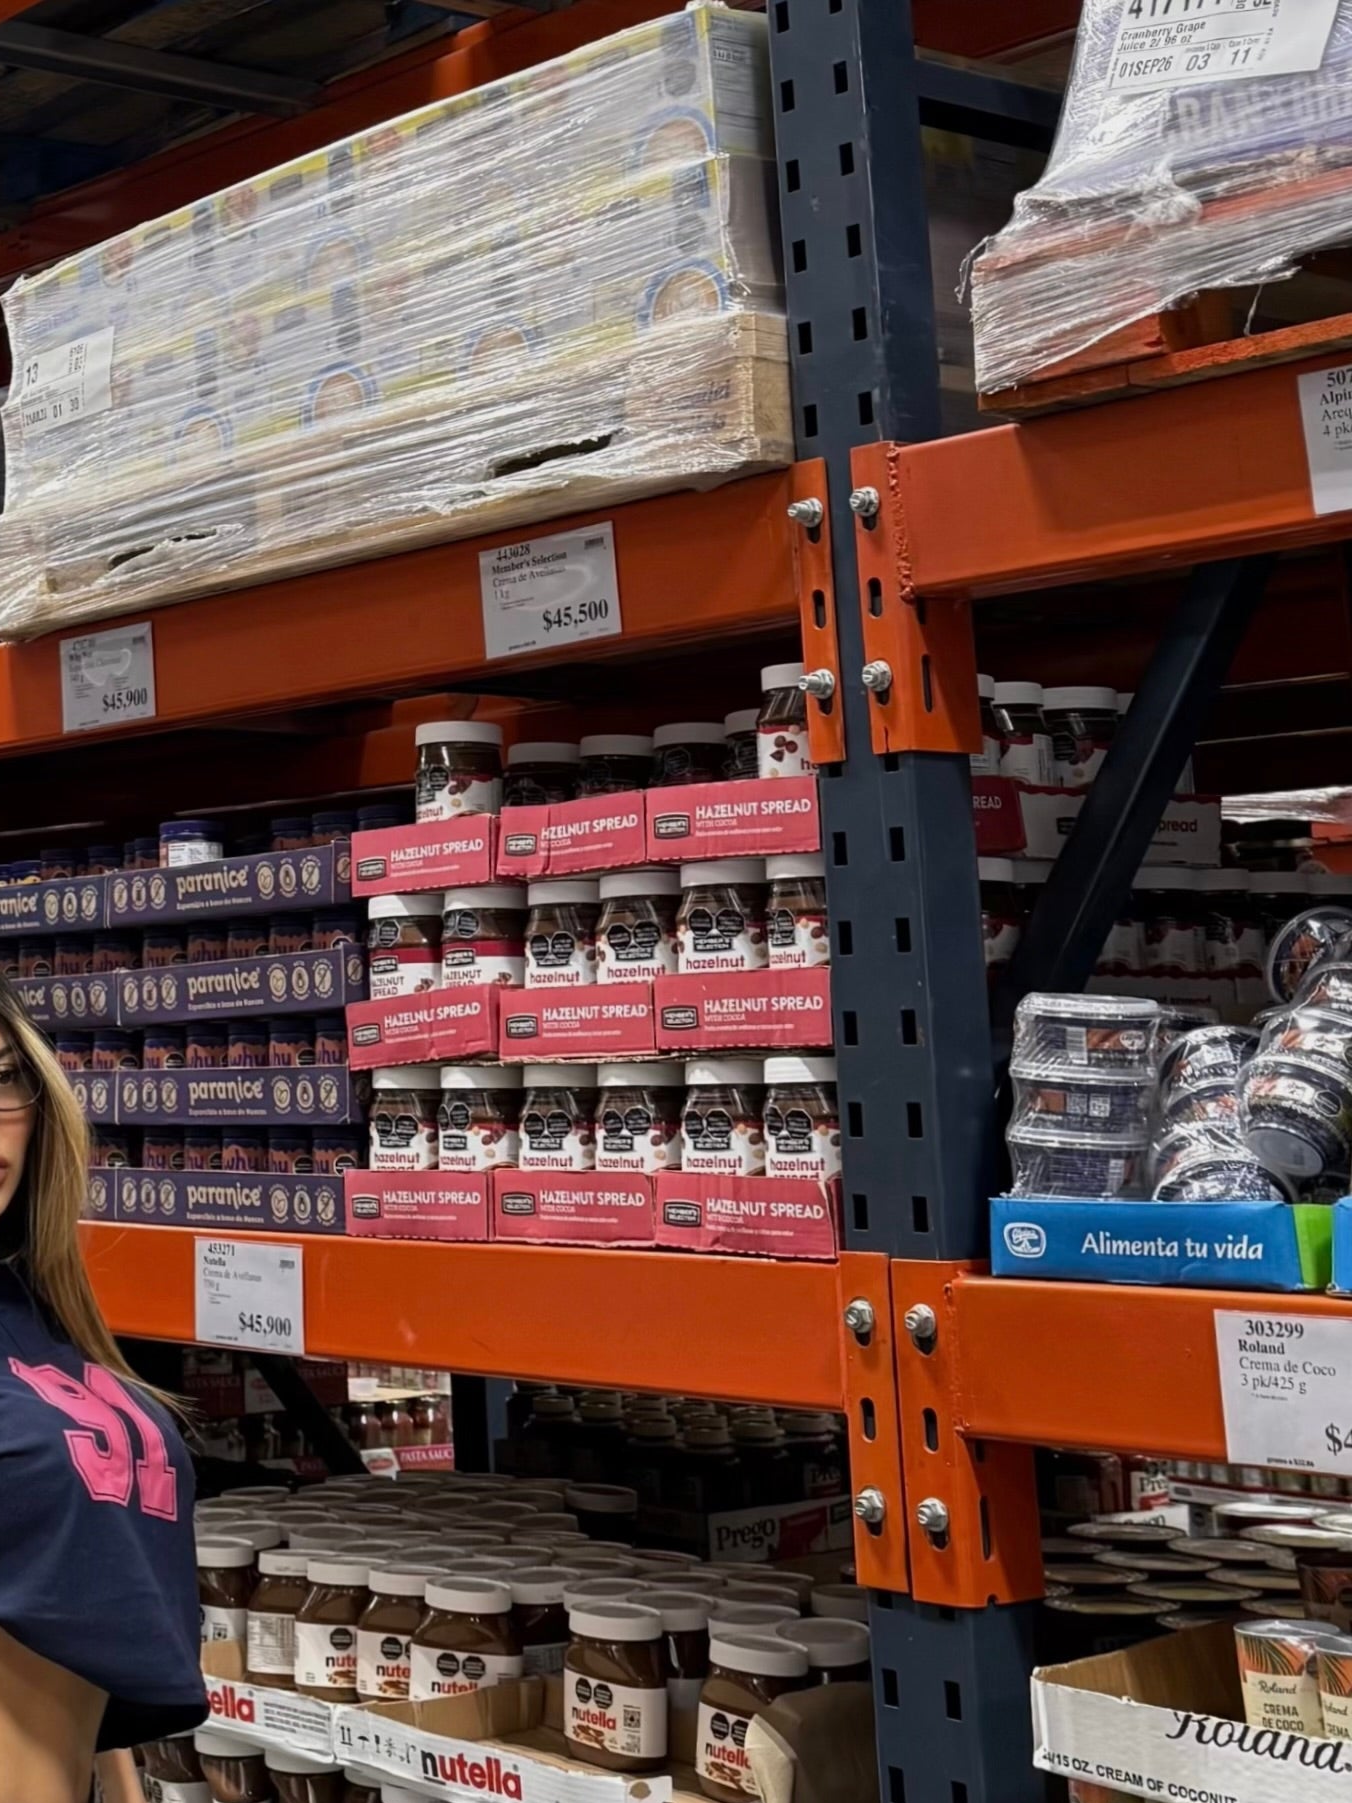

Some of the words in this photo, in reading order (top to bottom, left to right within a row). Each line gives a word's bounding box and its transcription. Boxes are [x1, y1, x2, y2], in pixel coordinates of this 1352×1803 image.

[1121, 24, 1173, 41] Cranberry
[1176, 21, 1206, 35] Grape
[1118, 40, 1145, 52] Juice
[1149, 38, 1161, 48] 2/
[1164, 35, 1177, 47] 96
[1180, 35, 1192, 44] oz
[1119, 55, 1173, 78] 01SEP26
[1185, 53, 1211, 72] 03
[1231, 48, 1251, 65] 11
[26, 362, 39, 386] 13
[1323, 425, 1330, 436] 4
[492, 558, 530, 575] Member's
[532, 551, 567, 567] Selection
[542, 598, 609, 632] $45,500
[102, 687, 148, 712] $45,900
[696, 803, 758, 819] HAZELNUT
[761, 799, 811, 814] SPREAD
[972, 796, 1002, 810] READ
[391, 844, 440, 862] HAZELNUT
[443, 839, 483, 854] SPREAD
[176, 865, 248, 898] paranice
[607, 964, 665, 978] hazelnut
[686, 955, 745, 969] hazelnut
[186, 967, 259, 1000] paranice
[531, 971, 580, 984] hazelnut
[543, 1006, 599, 1021] HAZELNUT
[602, 1004, 647, 1018] SPREAD
[704, 998, 767, 1013] HAZELNUT
[771, 996, 823, 1011] SPREAD
[188, 1076, 263, 1108] paranice
[375, 1152, 420, 1163] hazelnut
[523, 1155, 573, 1167] hazelnut
[687, 1156, 743, 1168] hazelnut
[186, 1182, 262, 1212] paranice
[383, 1191, 436, 1203] HAZELNUT
[438, 1192, 480, 1204] SPREAD
[540, 1190, 594, 1205] HAZELNUT
[597, 1192, 645, 1206] SPREAD
[706, 1198, 766, 1216] HAZELNUT
[770, 1203, 824, 1219] SPREAD
[207, 1242, 235, 1257] 453271
[1081, 1230, 1179, 1259] Alimenta
[1185, 1237, 1206, 1259] tu
[1214, 1234, 1264, 1261] vida
[203, 1256, 227, 1267] Nutella
[238, 1312, 292, 1338] $45,900
[1245, 1320, 1304, 1339] 303299
[1238, 1339, 1285, 1355] Roland
[1239, 1356, 1280, 1373] Crema
[1284, 1360, 1298, 1373] de
[1302, 1362, 1336, 1376] Coco
[1241, 1374, 1248, 1386] 3
[1252, 1374, 1294, 1390] pk/425
[1299, 1383, 1306, 1394] g
[400, 1451, 425, 1462] PASTA
[716, 1518, 775, 1552] Prego
[1257, 1680, 1297, 1695] Roland
[1263, 1702, 1299, 1718] CREMA
[1263, 1717, 1273, 1729] DE
[1274, 1716, 1305, 1731] COCO
[421, 1748, 522, 1801] nutella
[1072, 1757, 1094, 1775] OZ.
[1096, 1764, 1144, 1788] CREAM
[1147, 1778, 1165, 1792] OF
